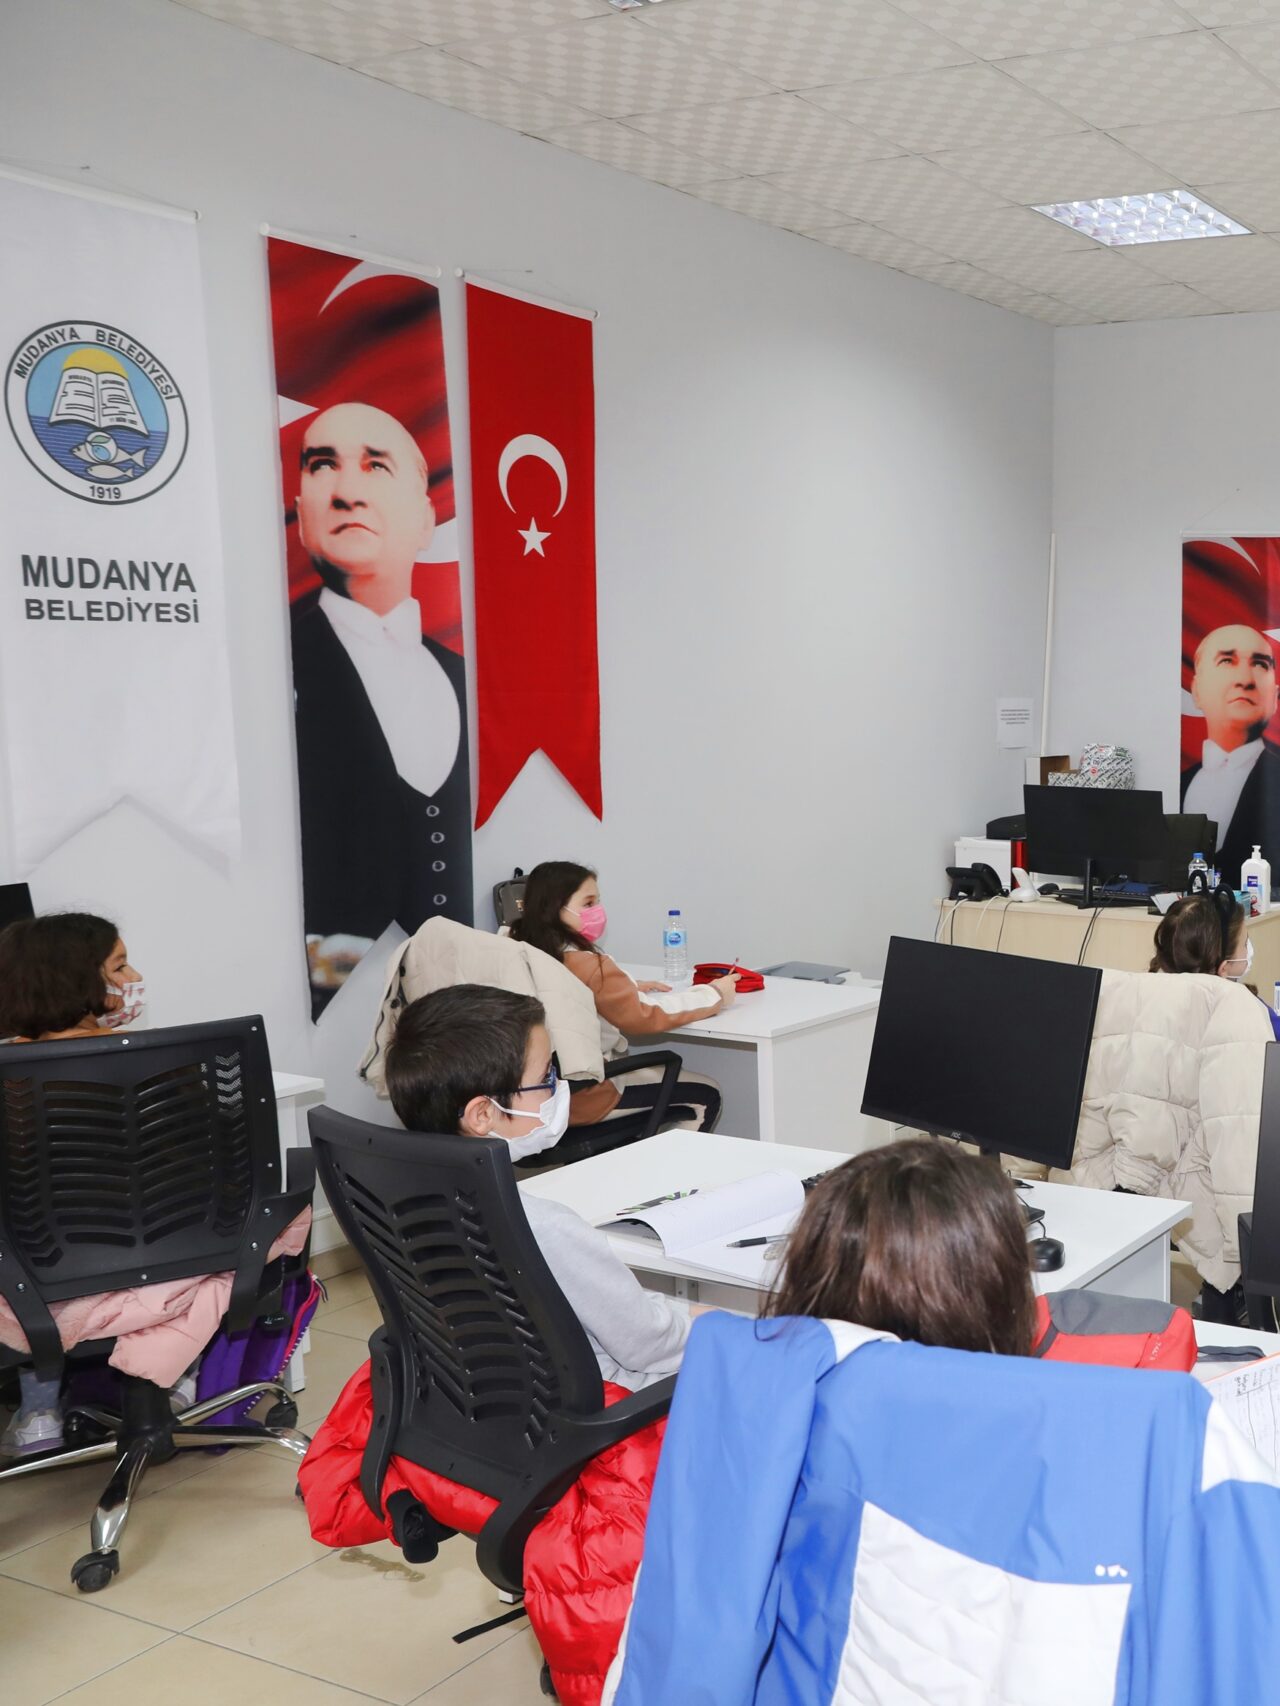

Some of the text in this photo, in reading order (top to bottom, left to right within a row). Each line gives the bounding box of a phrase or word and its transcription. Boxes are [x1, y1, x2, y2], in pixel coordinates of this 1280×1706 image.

[13, 327, 181, 401] MUDANYA BELEDİYESİ
[89, 485, 122, 500] 1919
[21, 554, 197, 593] MUDANYA
[24, 597, 200, 624] BELEDİYESİ
